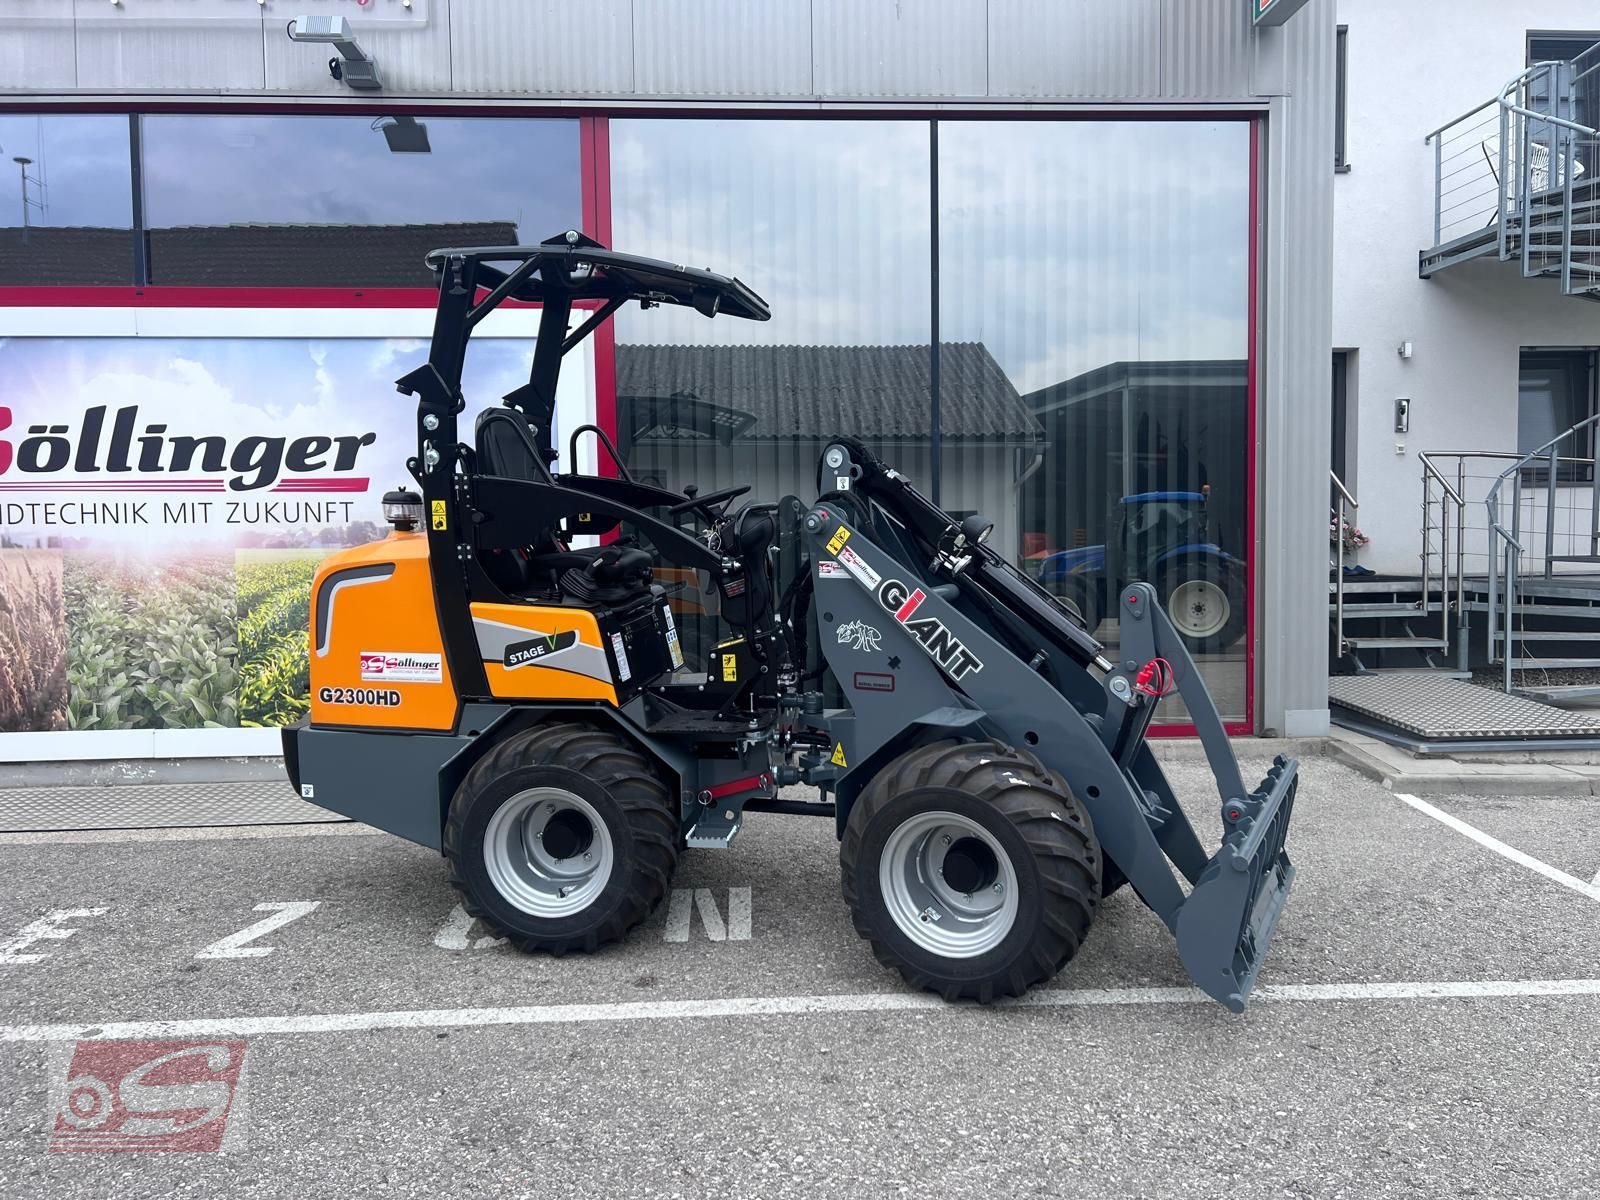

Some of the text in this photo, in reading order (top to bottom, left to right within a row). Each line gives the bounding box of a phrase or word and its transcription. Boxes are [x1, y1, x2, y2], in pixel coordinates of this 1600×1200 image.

[0, 502, 353, 524] DTECHNIK MIT ZUKUNFT
[509, 645, 545, 663] STAGE
[386, 657, 440, 671] Söllinger
[320, 688, 400, 706] G2300HD
